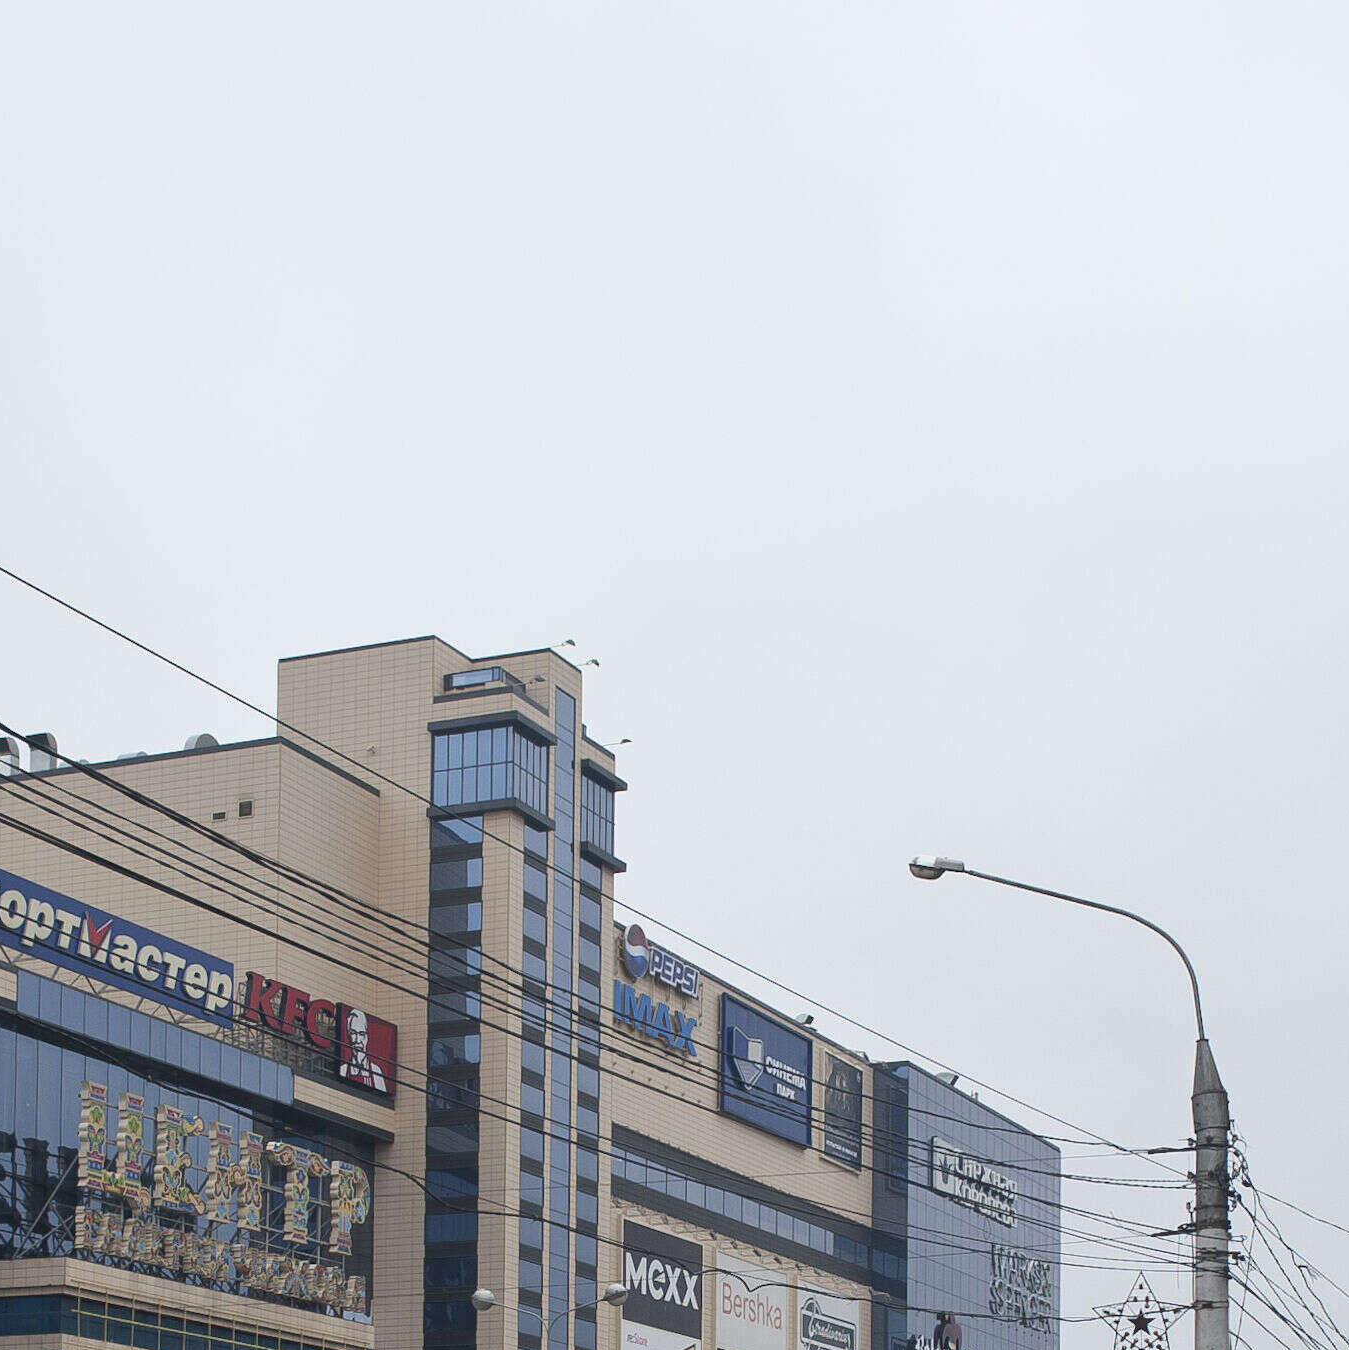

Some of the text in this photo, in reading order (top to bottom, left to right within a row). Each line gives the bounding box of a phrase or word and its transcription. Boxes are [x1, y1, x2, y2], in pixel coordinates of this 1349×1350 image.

[650, 949, 699, 998] PEPSI
[245, 972, 336, 1047] KFC
[613, 980, 697, 1056] IMAX
[776, 1083, 795, 1100] ПАРК
[77, 1080, 370, 1256] ЦЕНТР
[722, 1282, 782, 1329] Bershka
